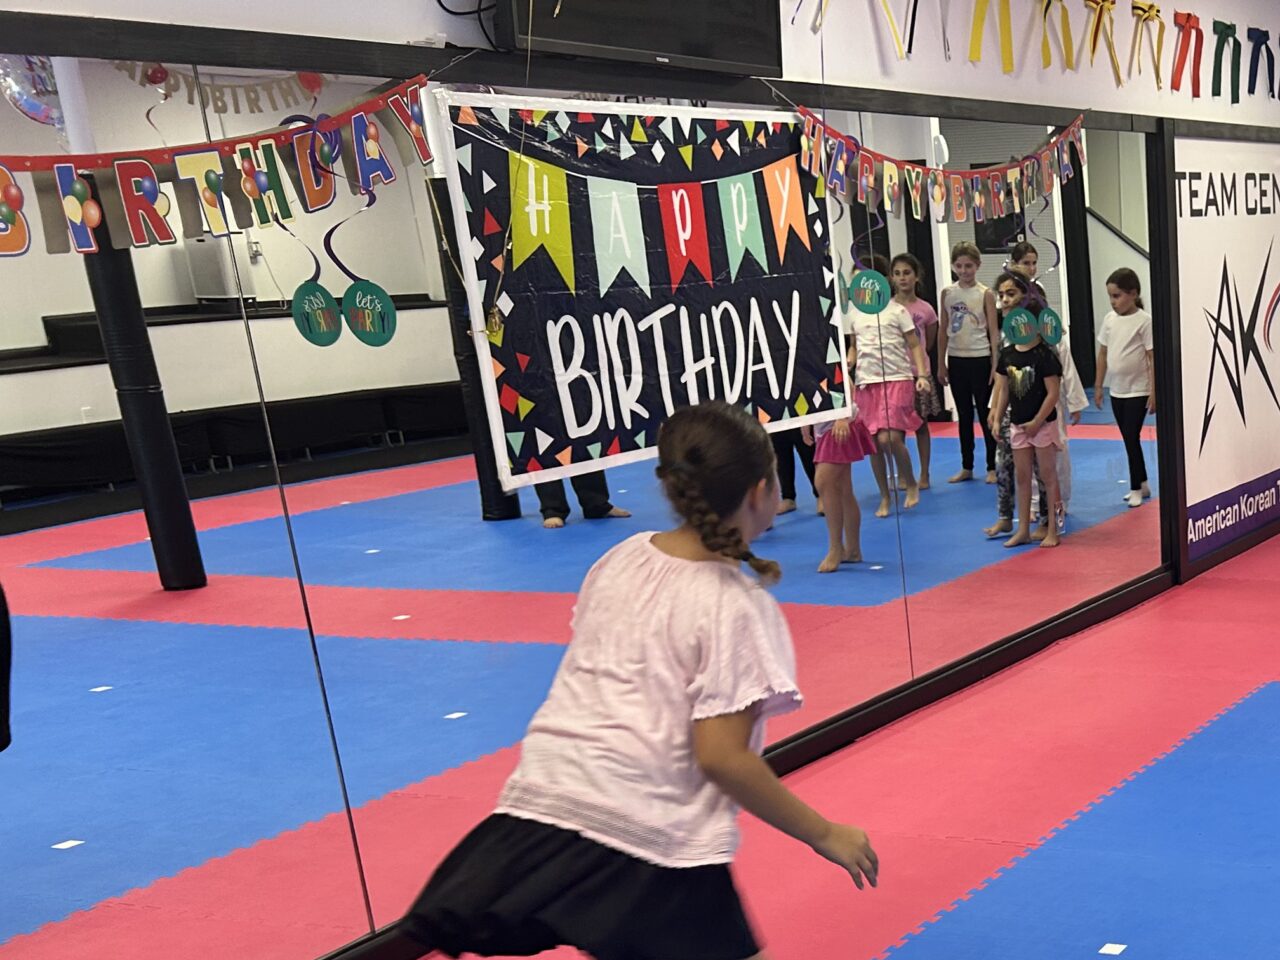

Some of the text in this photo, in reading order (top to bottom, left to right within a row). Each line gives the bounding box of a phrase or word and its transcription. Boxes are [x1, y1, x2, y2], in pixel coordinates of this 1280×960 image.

[525, 164, 792, 259] HAPPY
[1175, 171, 1238, 218] TEAM
[356, 291, 382, 312] let's
[546, 289, 800, 440] BIRTHDAY
[1187, 505, 1239, 544] American
[1240, 493, 1276, 519] Korean
